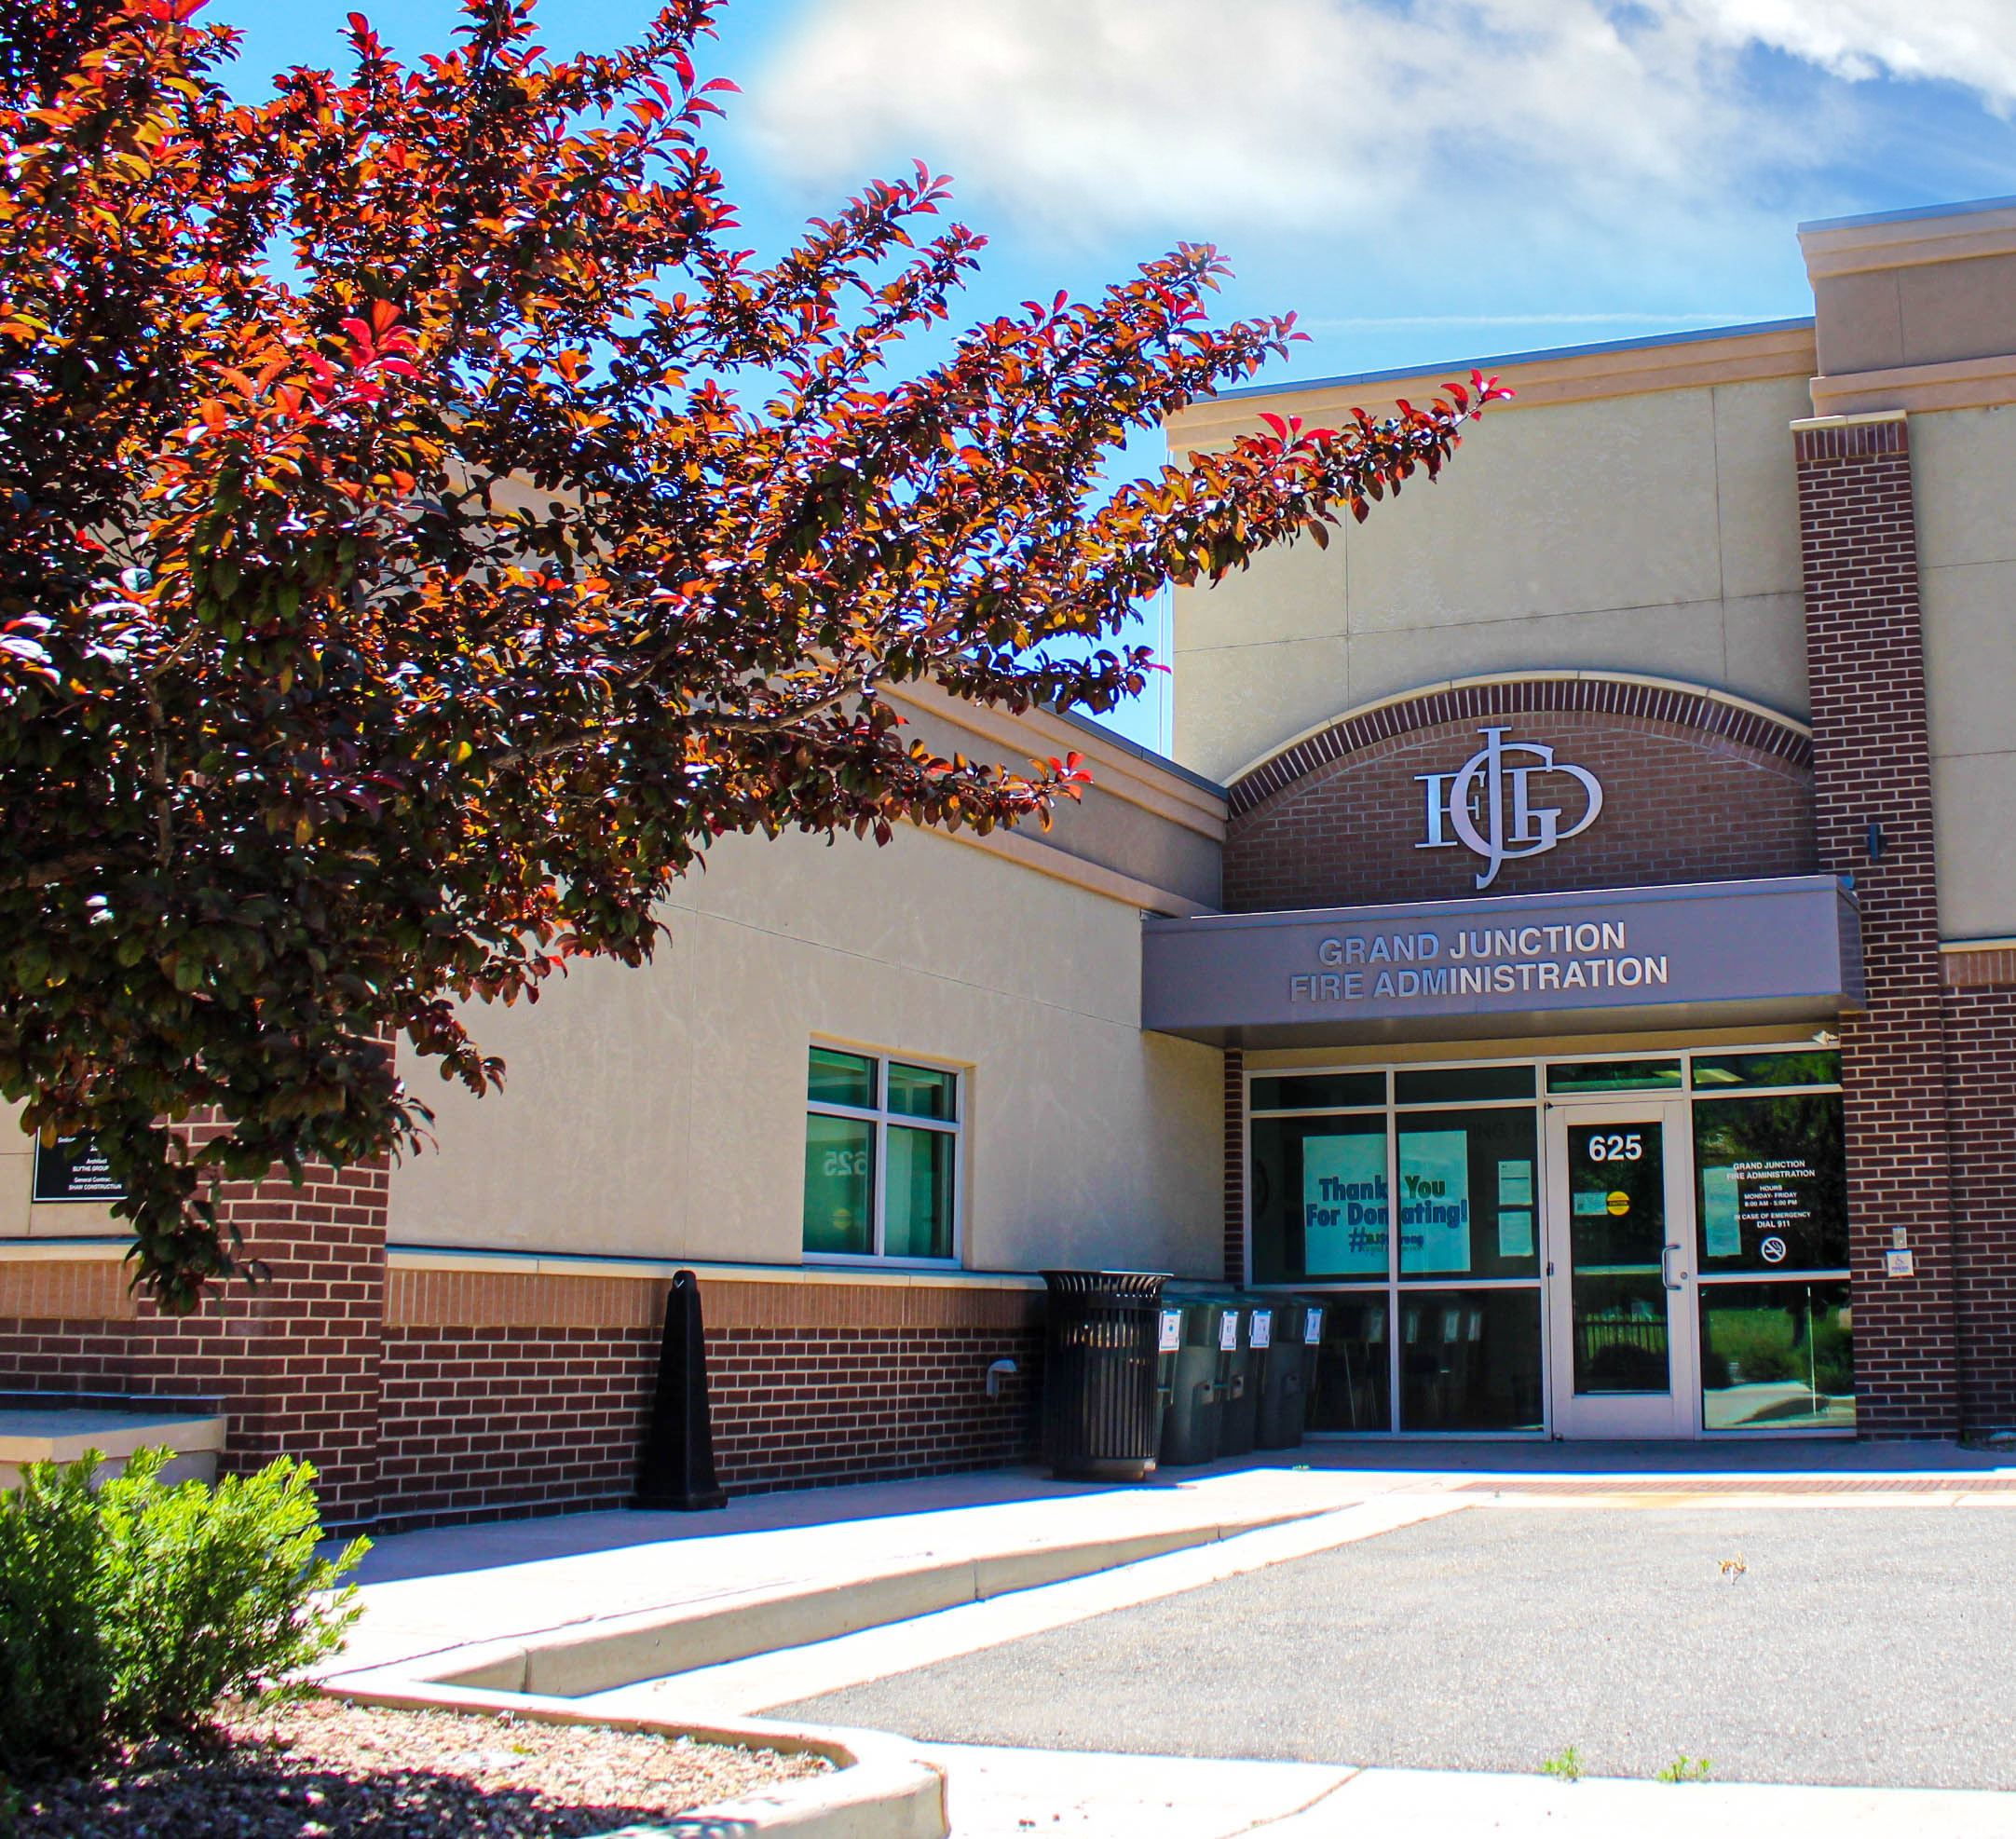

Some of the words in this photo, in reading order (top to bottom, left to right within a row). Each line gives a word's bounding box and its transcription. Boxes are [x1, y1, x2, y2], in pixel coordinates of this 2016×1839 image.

[1318, 933, 1439, 967] GRAND
[1449, 920, 1626, 960] JUNCTION
[1290, 972, 1364, 1003] FIRE
[1373, 955, 1669, 1000] ADMINISTRATION
[1588, 1134, 1642, 1162] 625
[1726, 1172, 1745, 1180] FIRE
[1747, 1169, 1816, 1180] ADMINISTRATION
[1733, 1162, 1763, 1170] GRAND
[1764, 1160, 1805, 1169] JUNCTION
[1318, 1175, 1388, 1202] Thank
[1405, 1175, 1446, 1200] You
[1306, 1203, 1342, 1228] For
[1756, 1220, 1776, 1229] DIAL
[1777, 1219, 1791, 1228] 911
[1770, 1211, 1812, 1219] EMERGENCY
